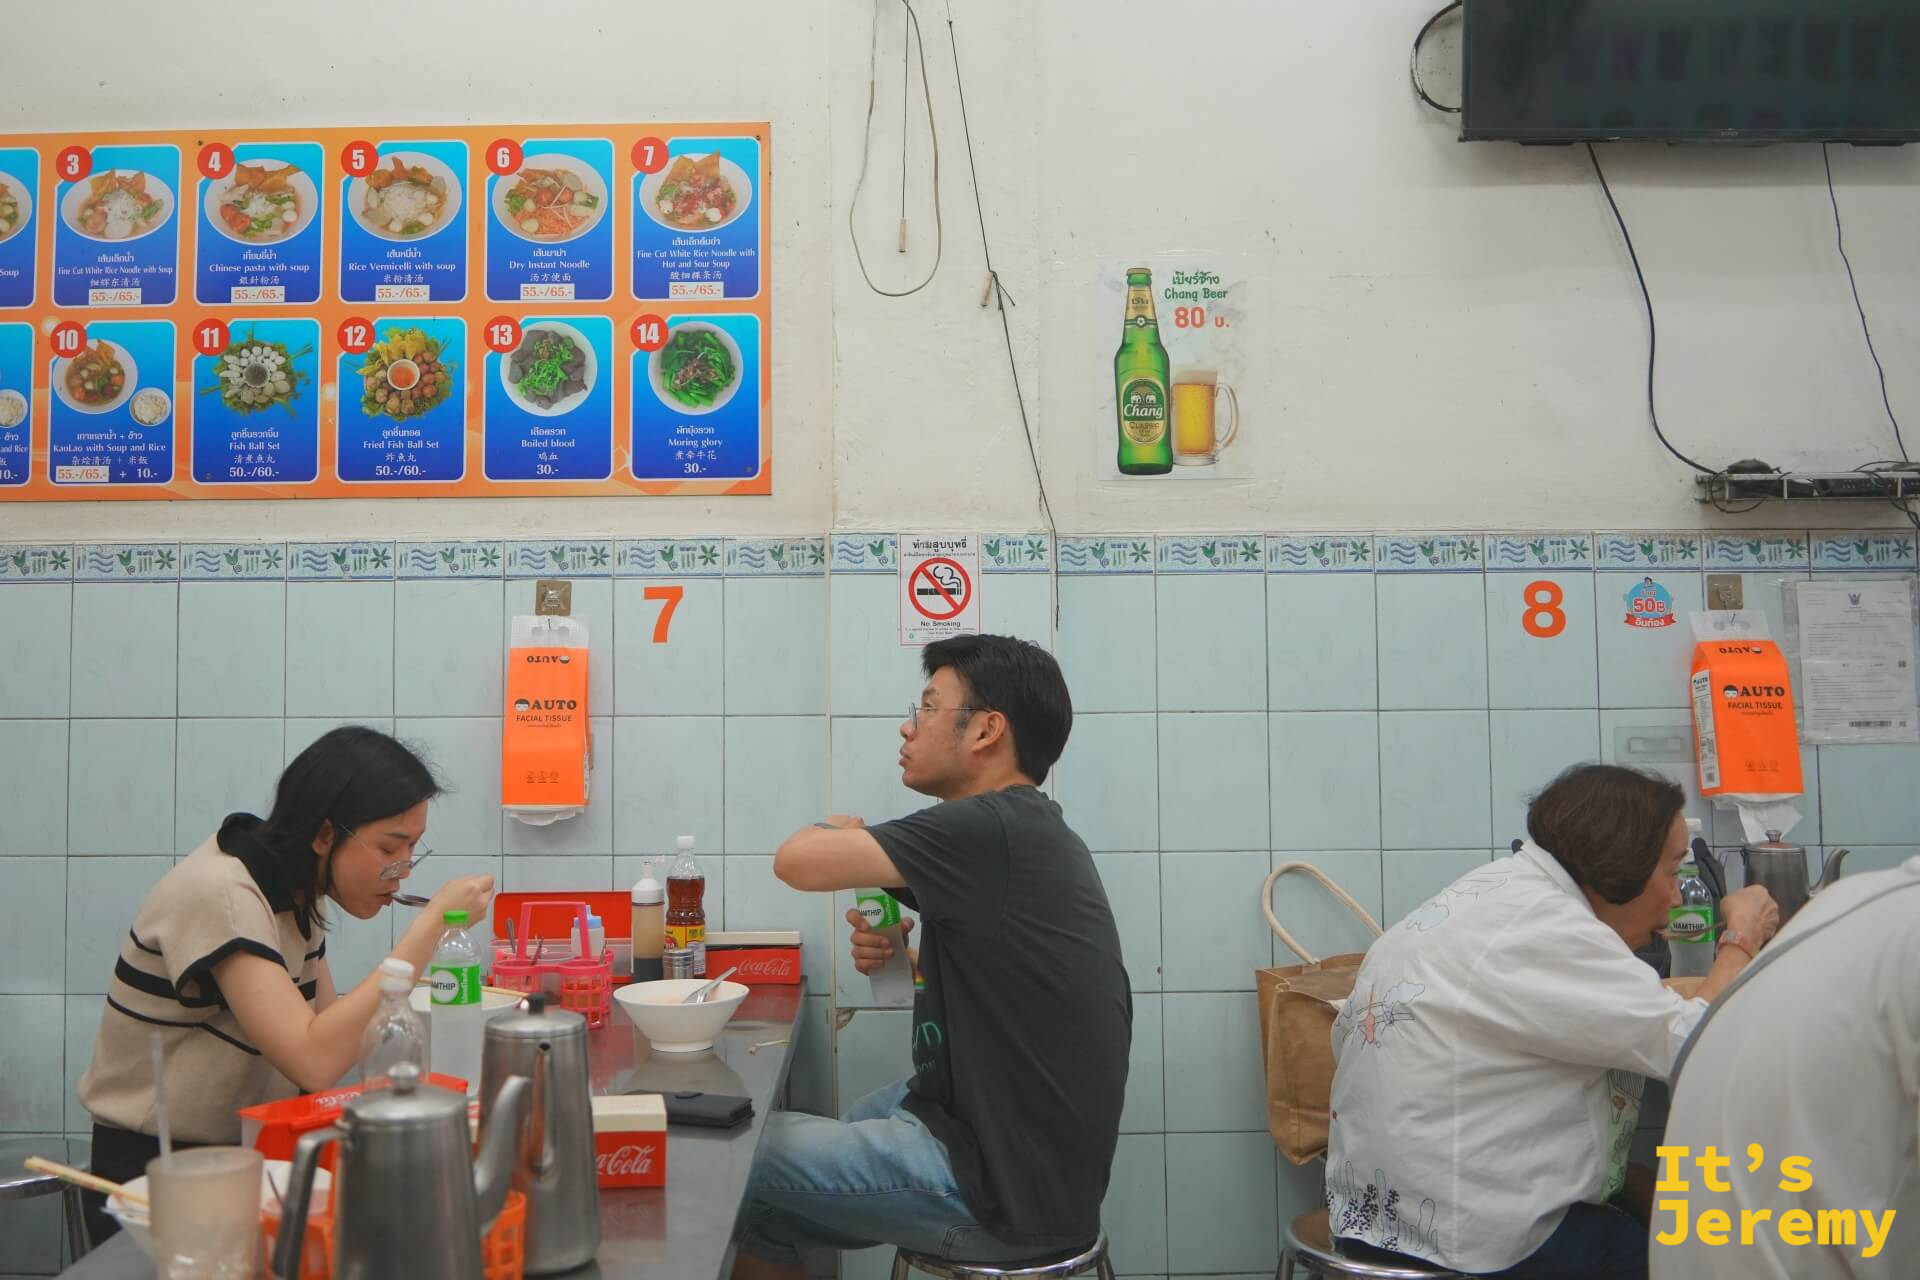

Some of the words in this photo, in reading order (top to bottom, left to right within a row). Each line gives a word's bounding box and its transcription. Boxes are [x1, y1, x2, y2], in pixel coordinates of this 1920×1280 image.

[208, 151, 222, 172] 4
[352, 149, 365, 170] 5
[497, 147, 510, 168] 6
[643, 145, 655, 167] 7
[66, 154, 80, 175] 3
[637, 249, 652, 258] Fine
[655, 249, 667, 258] Cut
[669, 249, 691, 257] White
[693, 249, 708, 257] Rice
[711, 248, 737, 257] Noodle
[739, 248, 755, 257] with
[85, 266, 103, 275] White
[119, 265, 141, 274] Noodle
[143, 266, 157, 274] with
[158, 265, 173, 276] Soup
[209, 263, 241, 272] Chinese
[244, 264, 265, 273] pasta
[269, 263, 287, 271] with
[290, 264, 310, 273] soup
[348, 262, 367, 271] Rice
[369, 262, 412, 271] Vermicelli
[415, 262, 433, 270] with
[436, 263, 456, 272] soup
[509, 260, 525, 271] Dry
[528, 260, 557, 269] Instant
[560, 259, 590, 269] Noodle
[662, 260, 676, 269] Hot
[678, 260, 692, 268] and
[694, 260, 709, 268] Sour
[712, 260, 730, 270] Soup
[234, 289, 283, 300] 55.-/65.-
[377, 288, 427, 298] 55.-/65.-
[522, 286, 572, 297] 55.-/65.-
[672, 285, 721, 295] 55.-/65.-
[1164, 287, 1198, 302] Chang
[1202, 287, 1228, 299] Beer
[92, 291, 140, 302] 55.-/65.-
[1175, 306, 1205, 329] 80
[201, 327, 220, 348] 11
[344, 325, 366, 347] 12
[490, 324, 513, 346] 13
[637, 323, 660, 344] 14
[56, 329, 79, 350] 10
[1123, 403, 1163, 419] Chang
[86, 443, 104, 452] with
[106, 443, 127, 454] Soup
[130, 443, 145, 452] and
[148, 443, 166, 451] Rice
[230, 441, 246, 450] Fish
[249, 441, 265, 450] Ball
[267, 441, 280, 450] Set
[363, 440, 385, 449] Fried
[387, 440, 404, 449] Fish
[407, 440, 423, 449] Ball
[426, 440, 440, 449] Set
[521, 439, 548, 448] Boiled
[550, 439, 575, 448] blood
[668, 437, 699, 449] Moring
[701, 437, 723, 449] glory
[229, 466, 280, 477] 50.-/60.-
[375, 465, 427, 476] 50.-/60.-
[536, 464, 560, 475] 30.-
[684, 462, 707, 474] 30.-
[58, 469, 107, 480] 55.-/65.-
[137, 468, 158, 479] 10.-
[643, 585, 684, 643] 7
[1522, 579, 1566, 638] 8
[932, 620, 961, 628] Smoking
[527, 655, 559, 663] AUTO
[1740, 686, 1785, 697] AUTO
[531, 699, 577, 710] AUTO
[1728, 701, 1753, 709] FACIAL
[1755, 701, 1782, 710] TISSUE
[516, 714, 542, 722] FACIAL
[545, 714, 572, 722] TISSUE
